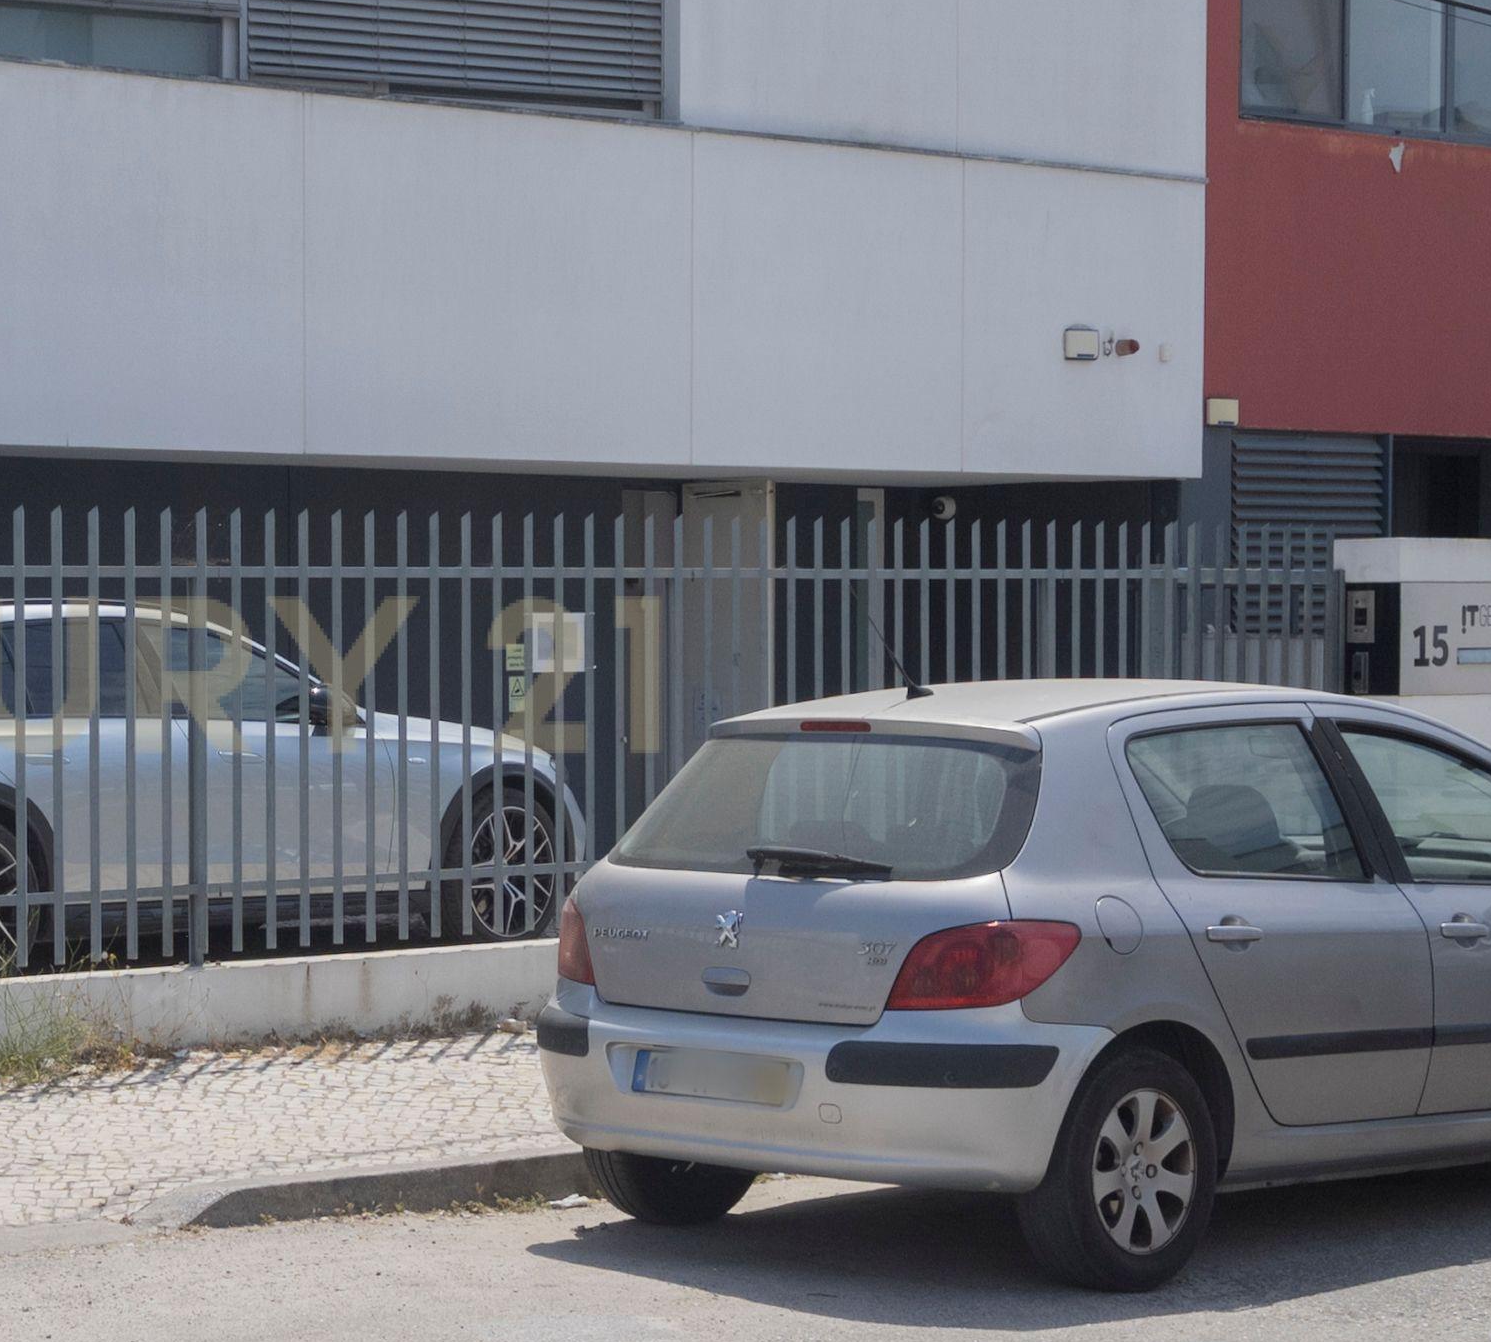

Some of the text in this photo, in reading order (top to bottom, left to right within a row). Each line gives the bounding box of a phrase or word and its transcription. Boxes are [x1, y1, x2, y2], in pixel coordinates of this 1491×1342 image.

[1413, 625, 1449, 667] 15
[593, 925, 651, 941] PEUGEOT
[857, 941, 898, 956] 307
